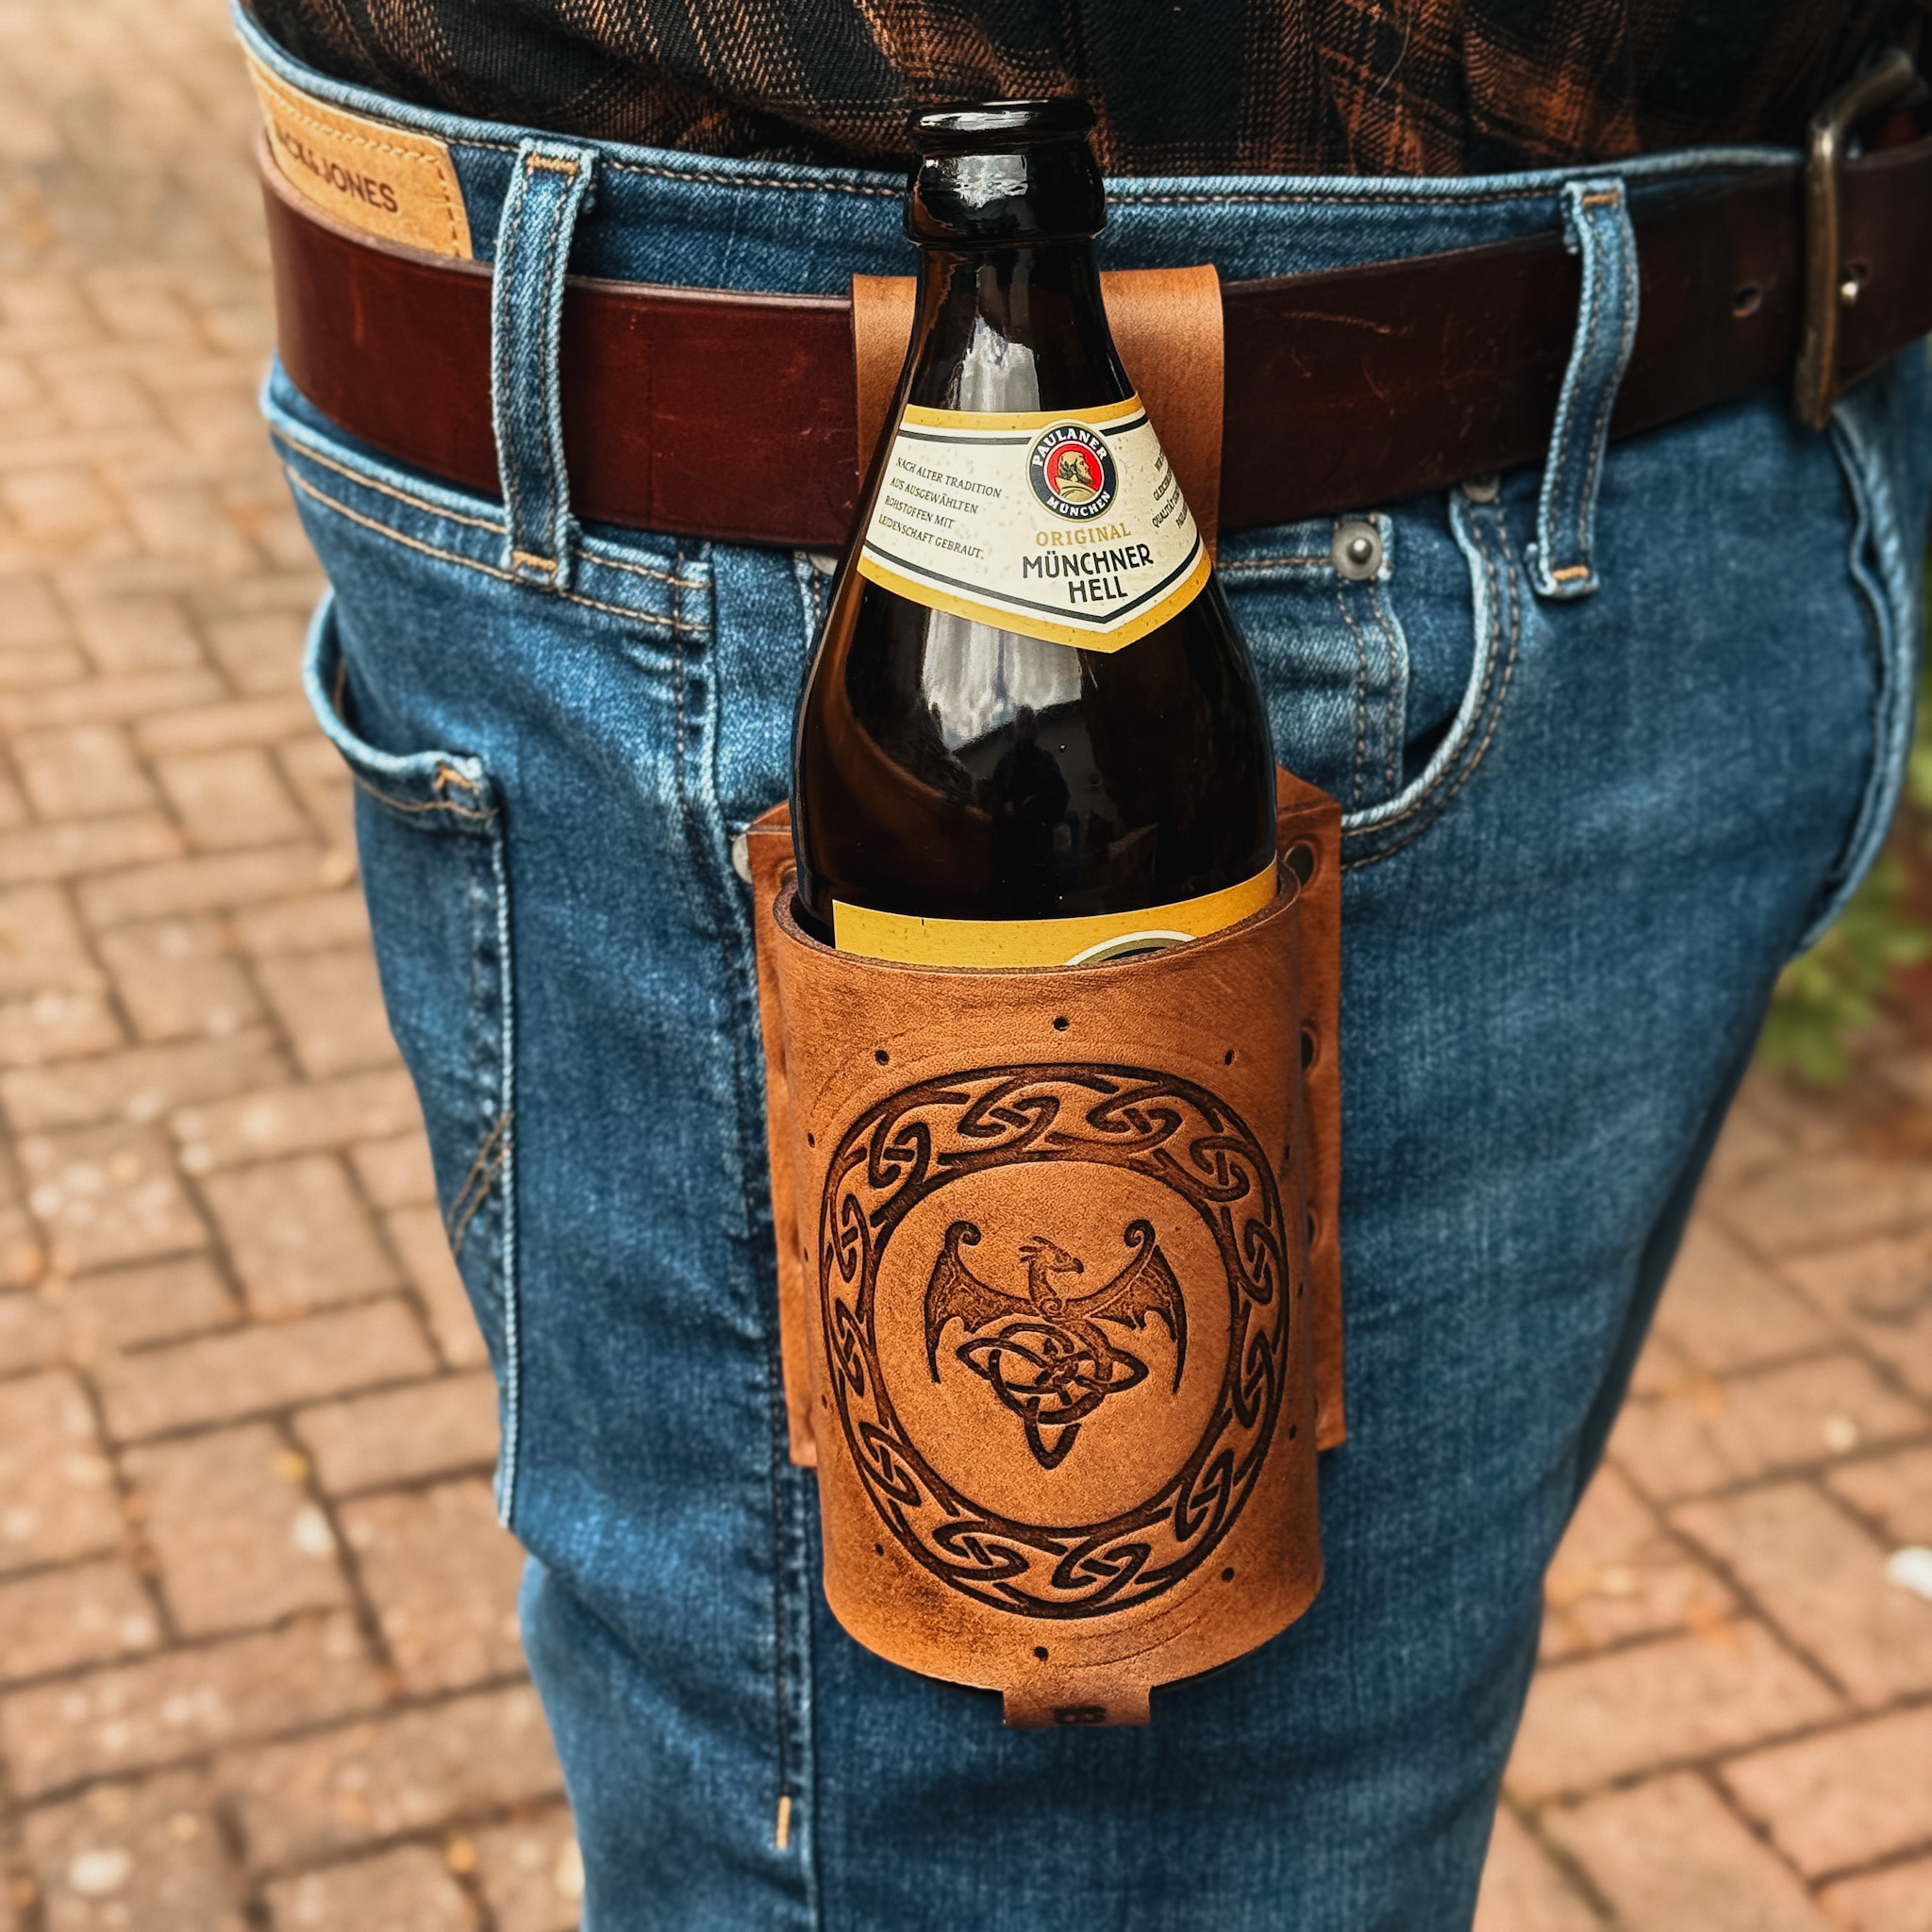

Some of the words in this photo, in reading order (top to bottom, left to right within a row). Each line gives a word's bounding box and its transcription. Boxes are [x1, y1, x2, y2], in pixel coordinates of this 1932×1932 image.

[1032, 428, 1108, 467] PAULANER
[890, 476, 905, 490] AUS
[904, 483, 979, 514] AUSGEWÄHLTEN
[896, 457, 917, 473] NACH
[916, 466, 943, 483] ALTER
[945, 475, 1003, 498] TRADITION
[885, 495, 934, 523] ROHSTOFFEN
[934, 514, 956, 528] MIT
[1046, 490, 1111, 516] MÜNCHEN
[878, 513, 935, 544] LEIDENSCHAFT
[935, 536, 984, 560] GEBRAUT.
[1036, 523, 1131, 546] ORIGINAL
[1023, 543, 1153, 578] MÜNCHNER
[1068, 576, 1127, 604] HELL
